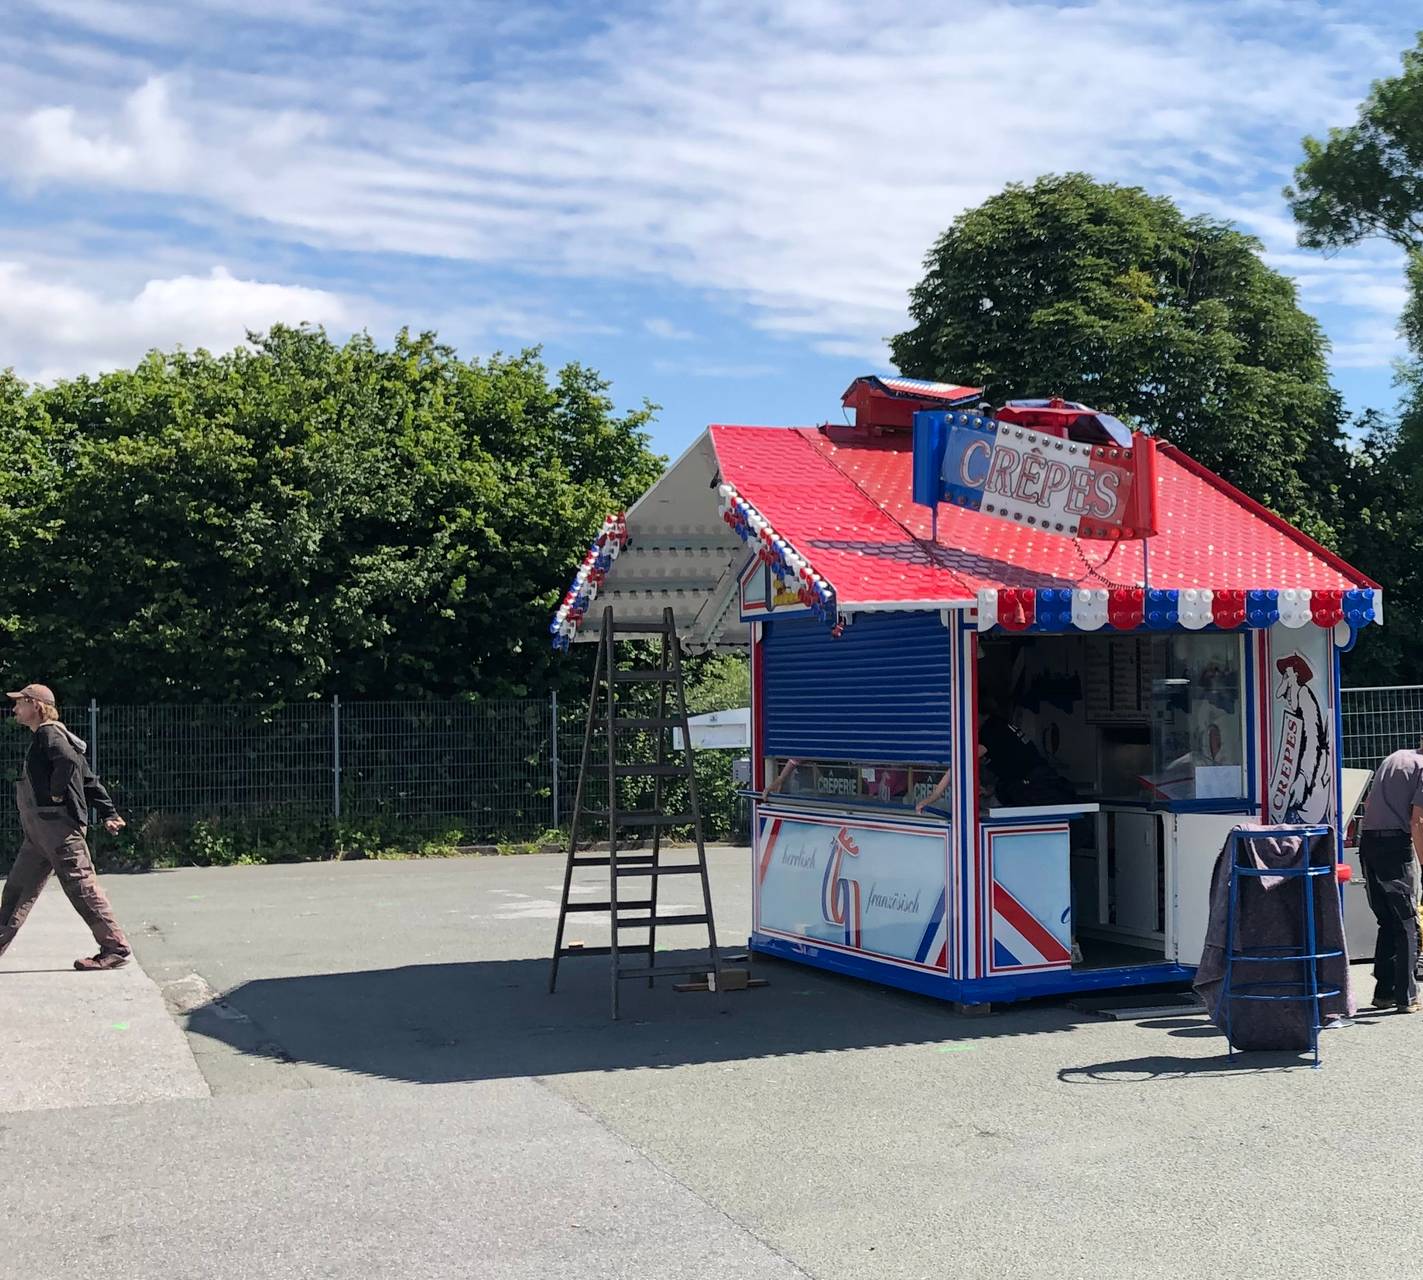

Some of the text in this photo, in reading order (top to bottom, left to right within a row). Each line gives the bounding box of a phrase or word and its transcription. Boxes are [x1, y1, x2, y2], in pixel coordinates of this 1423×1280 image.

[960, 439, 1120, 519] CRÊPES
[817, 769, 857, 796] CRÊPERIE
[1273, 719, 1298, 811] CREPES
[865, 882, 922, 914] französisch
